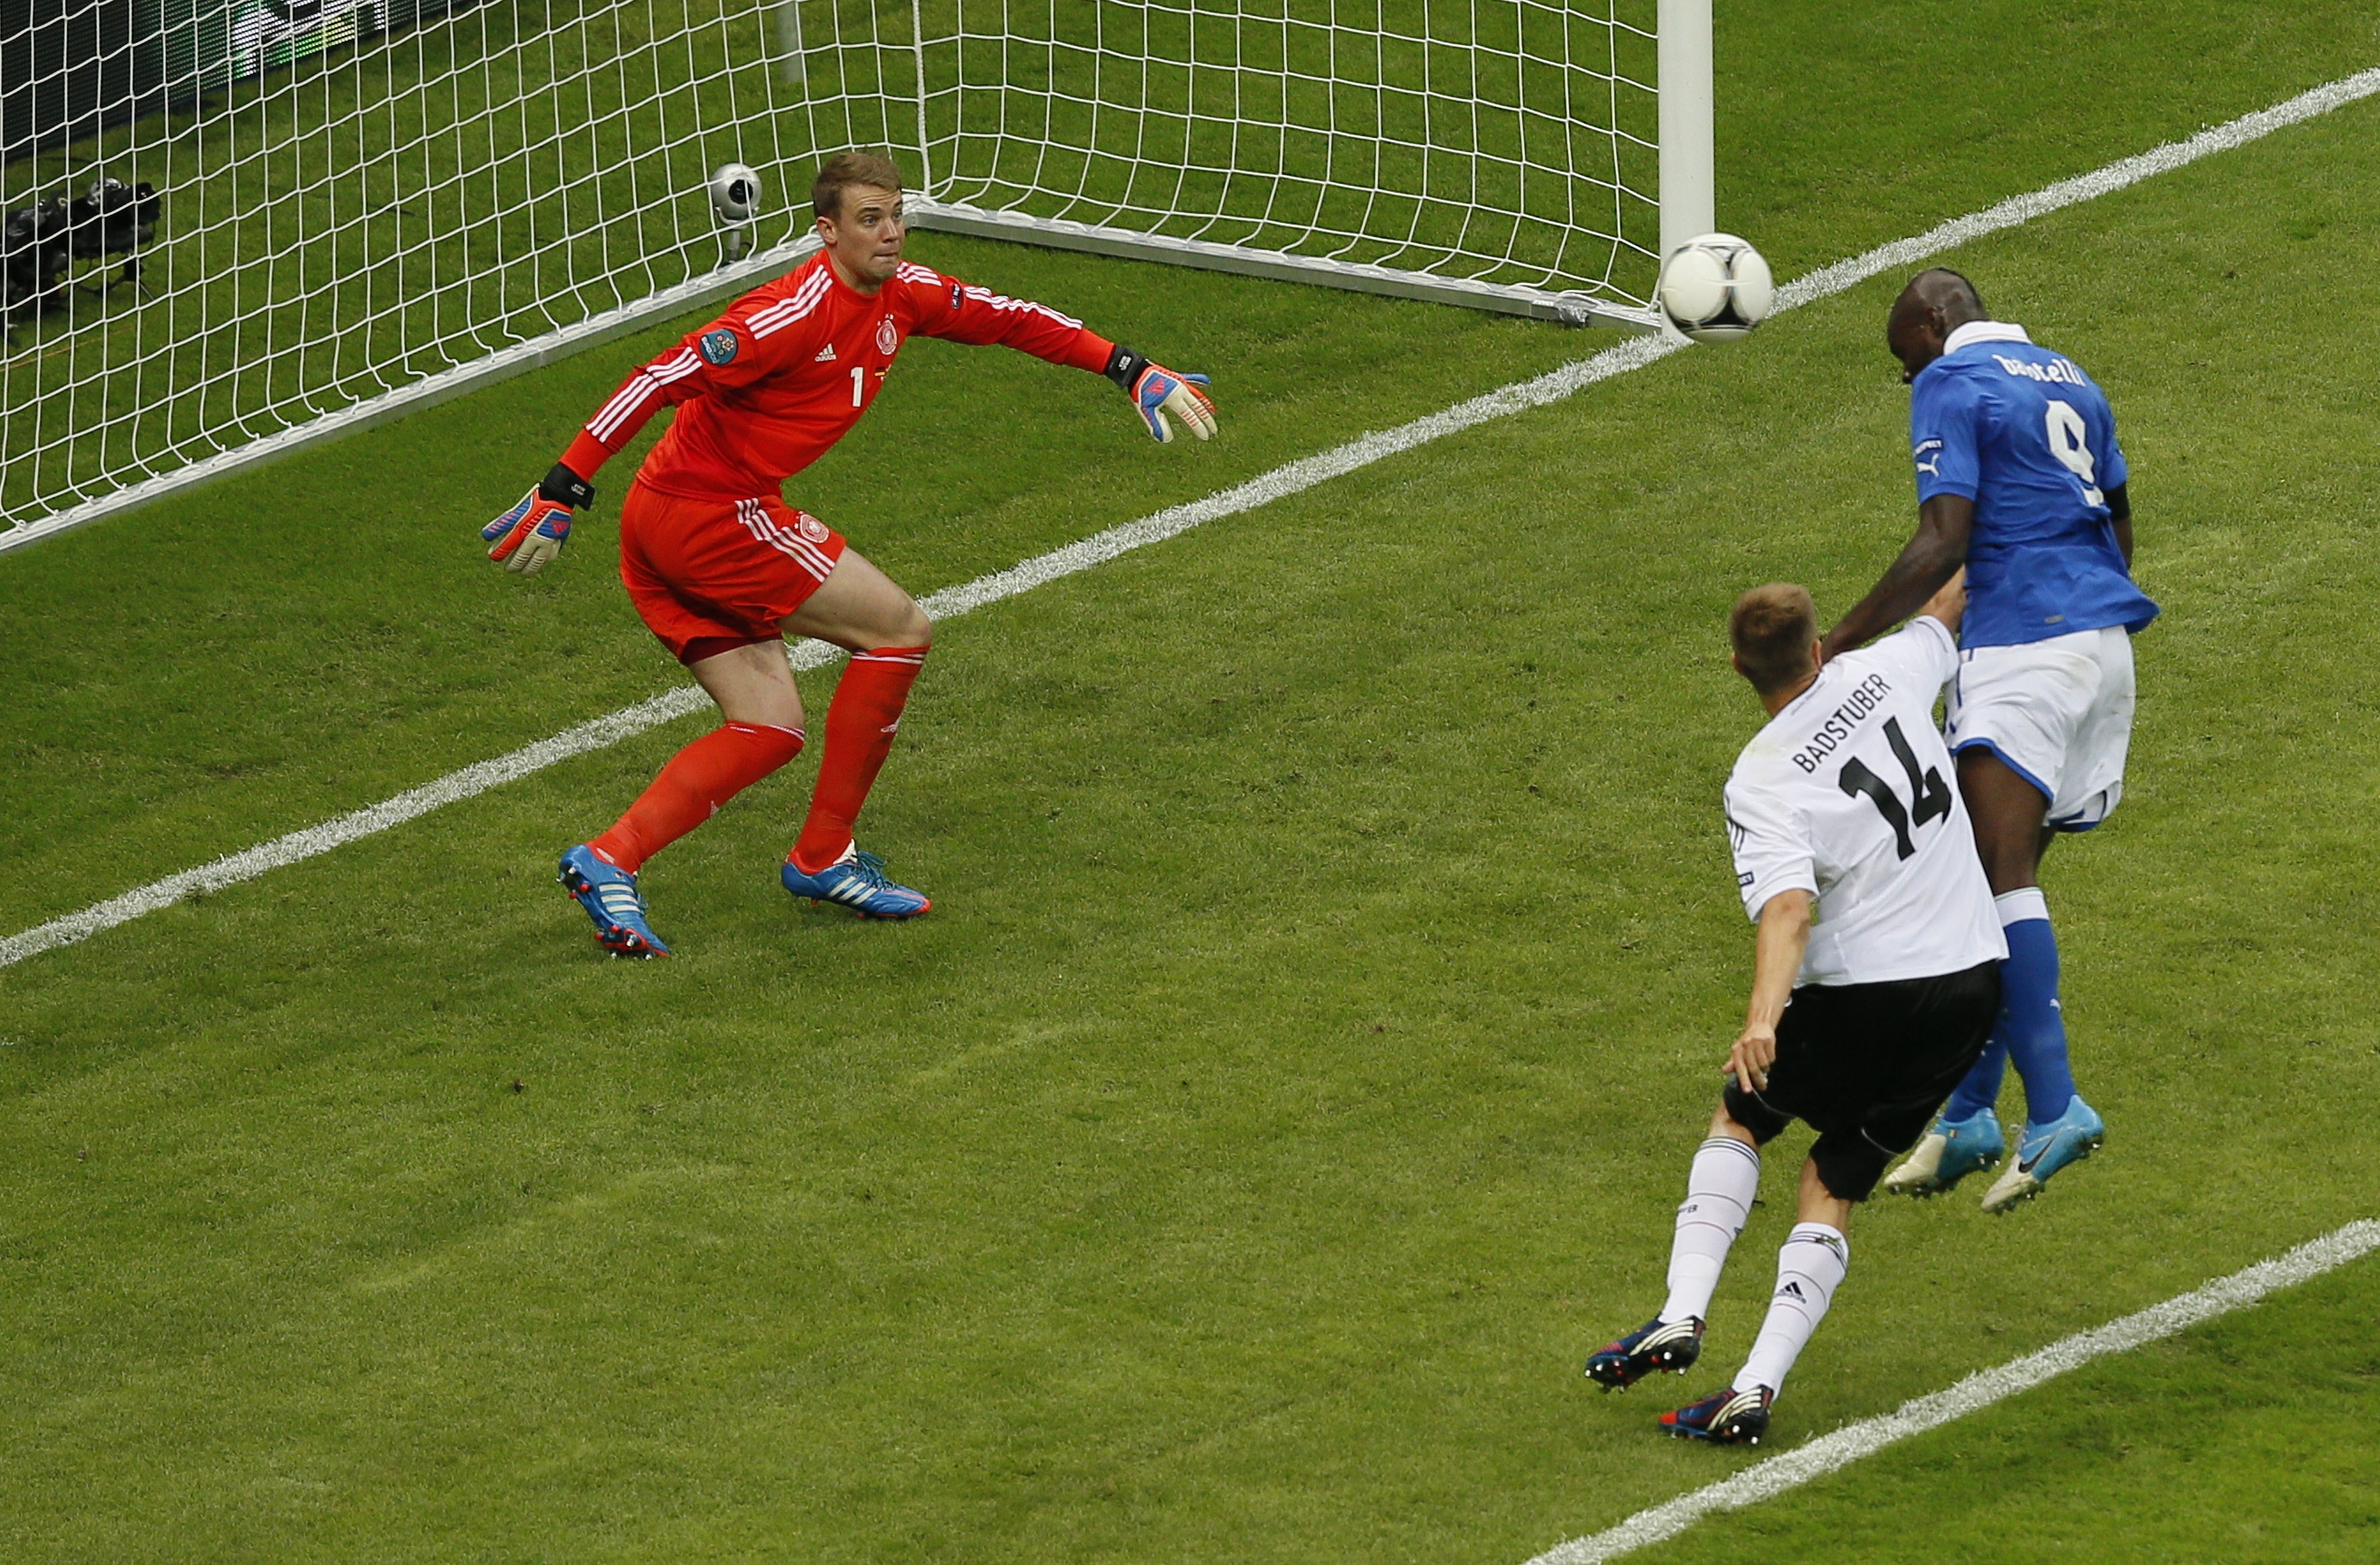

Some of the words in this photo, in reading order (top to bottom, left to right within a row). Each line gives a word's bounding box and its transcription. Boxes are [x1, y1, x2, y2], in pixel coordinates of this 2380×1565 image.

[850, 366, 864, 408] 1
[2045, 400, 2105, 508] 9
[1792, 673, 1893, 775] BADSTUBER
[1839, 714, 1953, 861] 14
